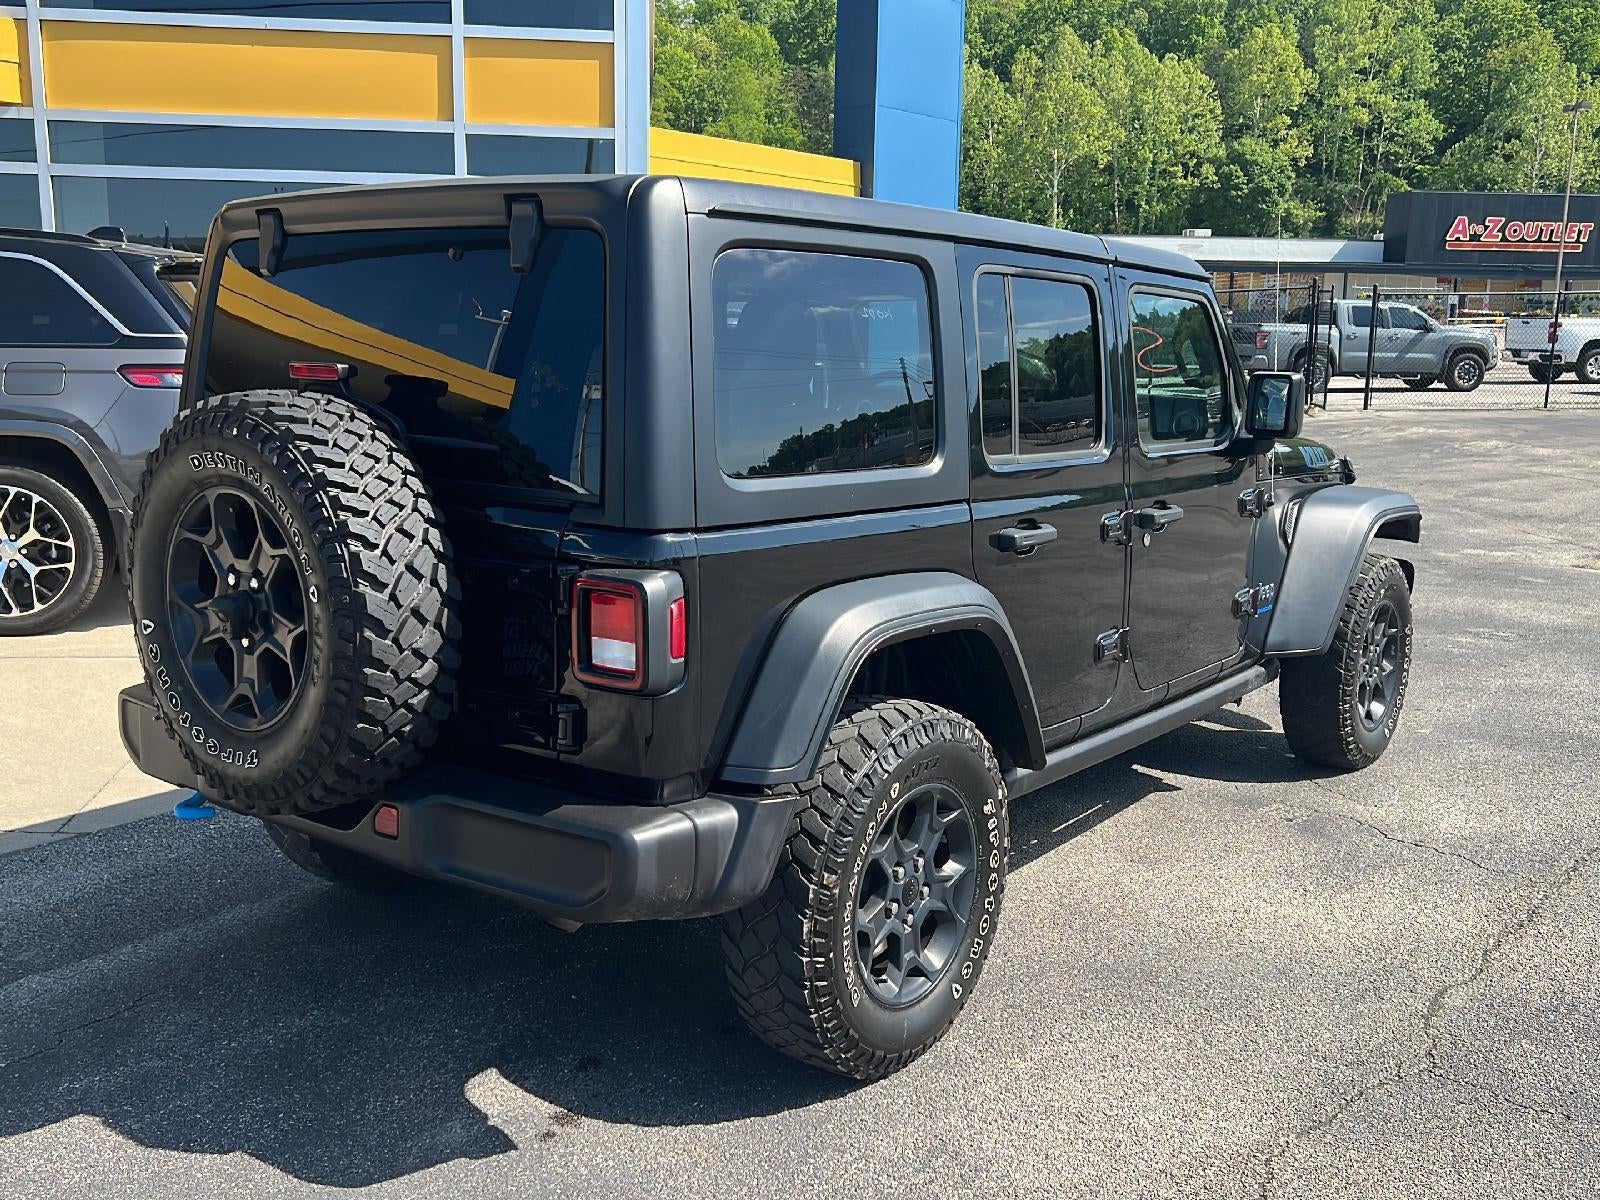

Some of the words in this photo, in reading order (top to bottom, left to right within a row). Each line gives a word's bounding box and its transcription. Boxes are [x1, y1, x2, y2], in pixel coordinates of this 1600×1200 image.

[1505, 221, 1594, 243] OUTLET
[1256, 298, 1279, 306] LOCA
[188, 452, 315, 576] DESTINATION
[842, 798, 889, 1009] DESTINATION
